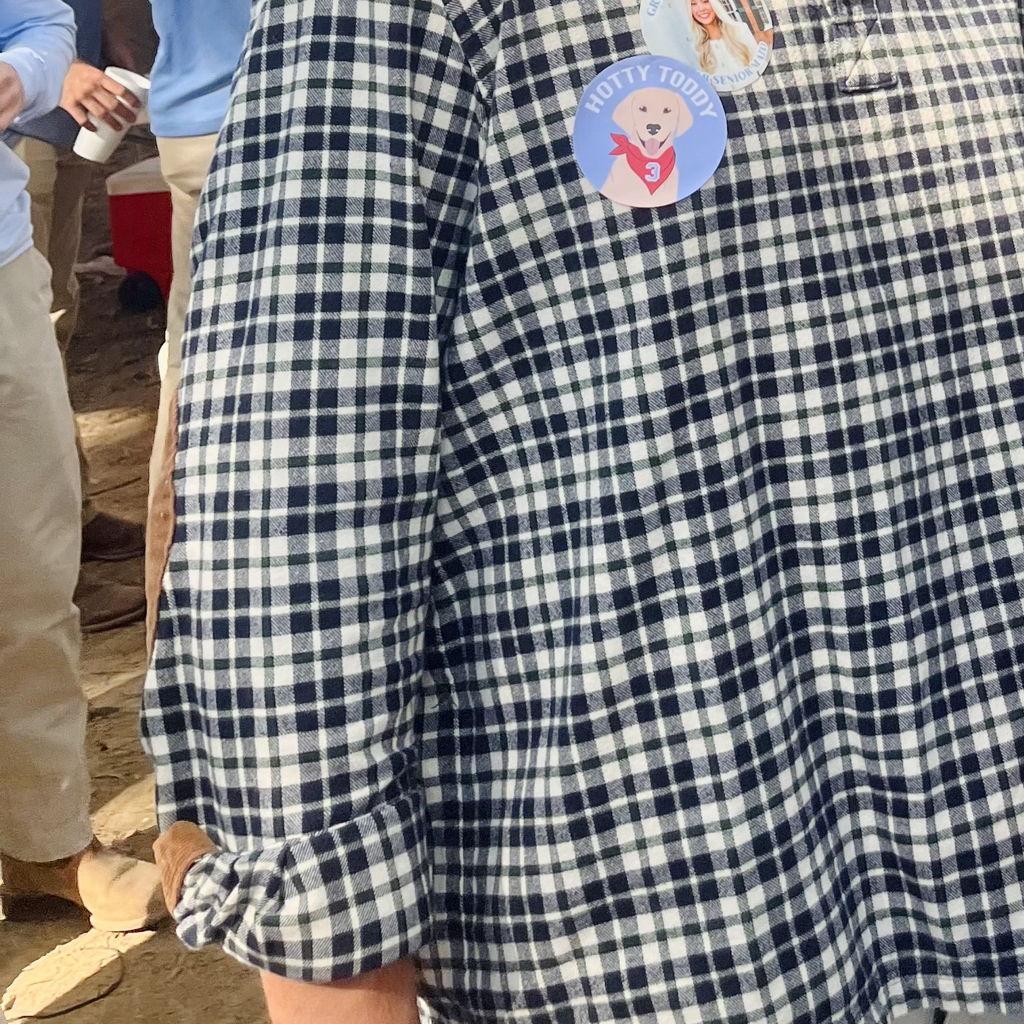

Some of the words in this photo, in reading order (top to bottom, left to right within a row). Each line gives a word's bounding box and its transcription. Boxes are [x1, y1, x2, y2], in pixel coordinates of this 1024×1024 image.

[584, 64, 650, 115] HOTTY
[658, 64, 718, 118] TODDY
[642, 161, 662, 183] 3
